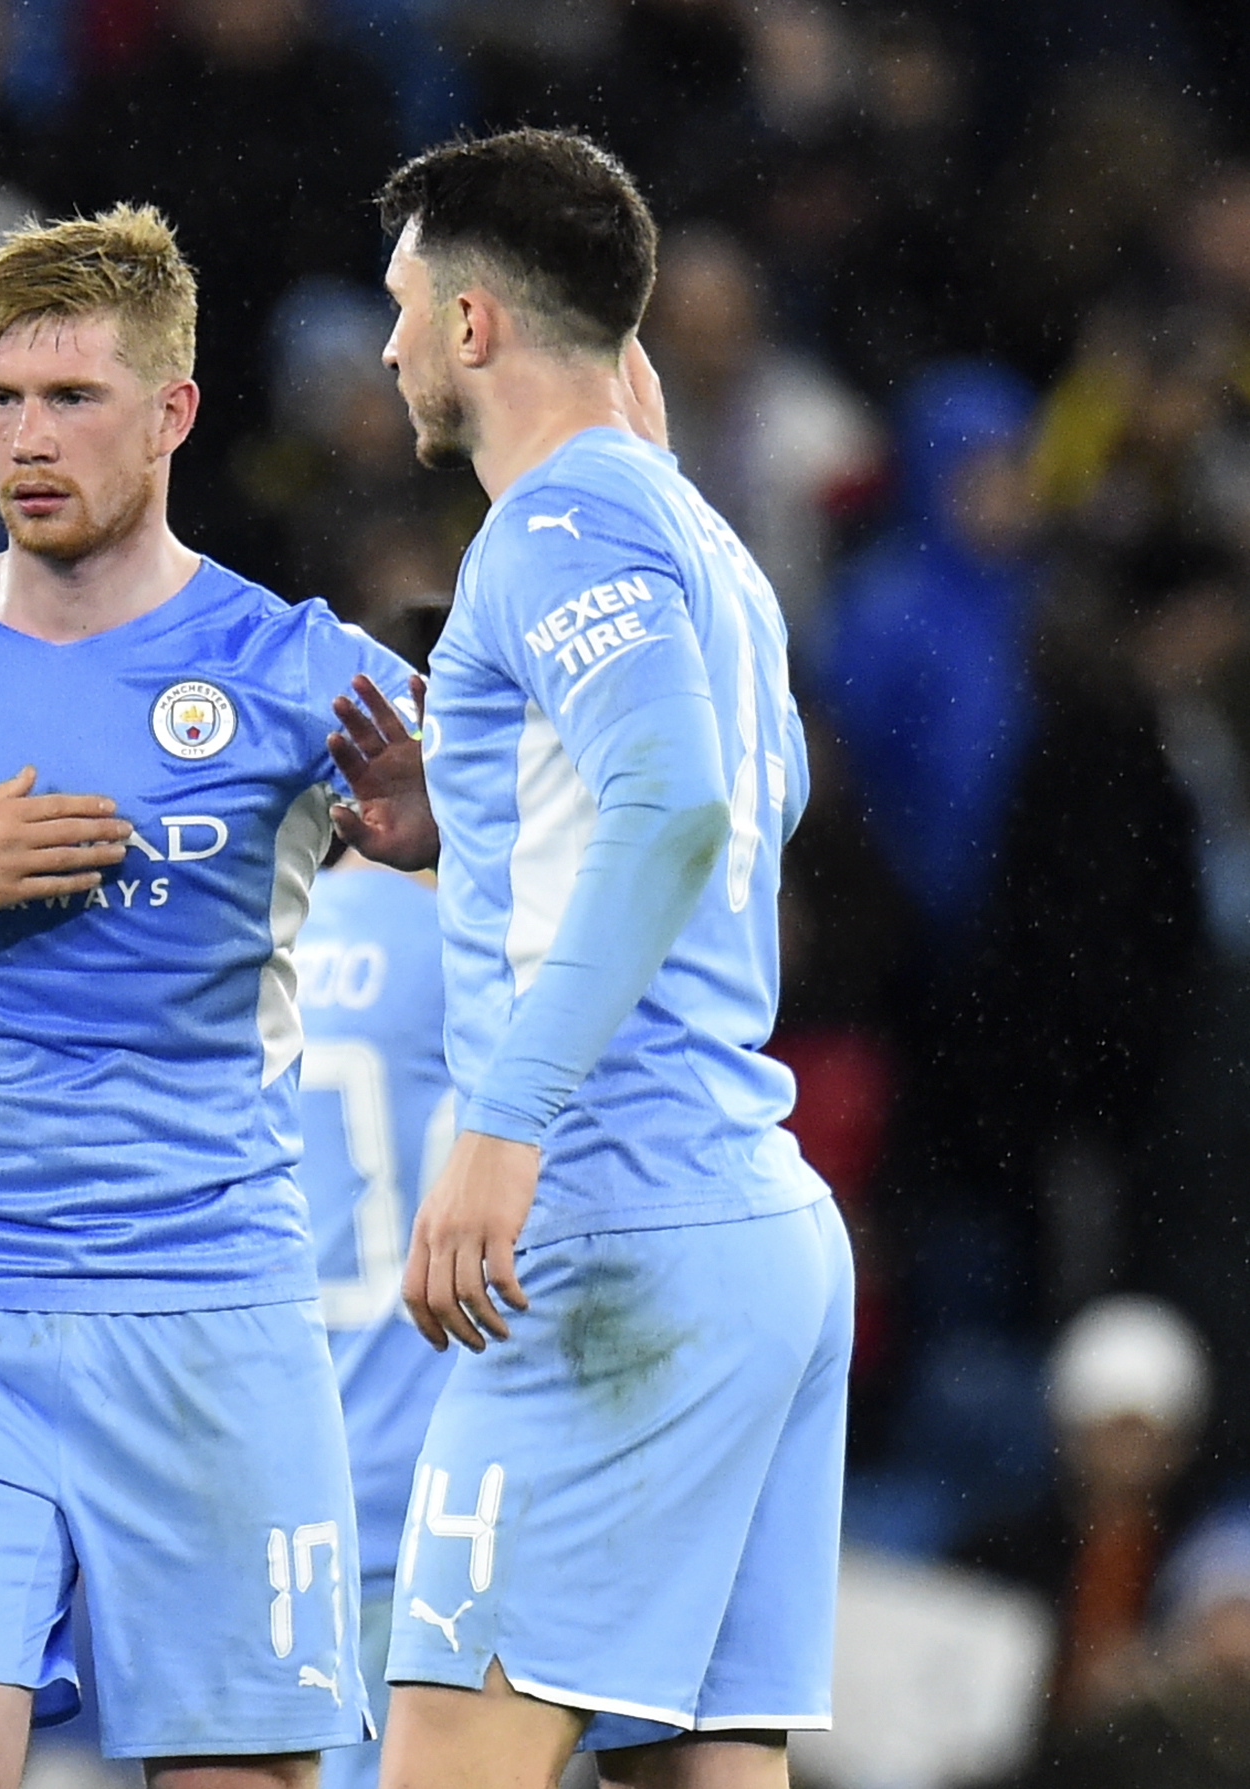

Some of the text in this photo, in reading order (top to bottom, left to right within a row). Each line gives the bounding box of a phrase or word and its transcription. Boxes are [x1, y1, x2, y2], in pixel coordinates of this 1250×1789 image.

[524, 575, 653, 659] NEXEN
[555, 611, 647, 675] TIRE
[159, 684, 228, 711] MANCHESTER
[180, 747, 206, 757] CITY
[403, 1462, 505, 1594] 14
[266, 1518, 345, 1660] 17
